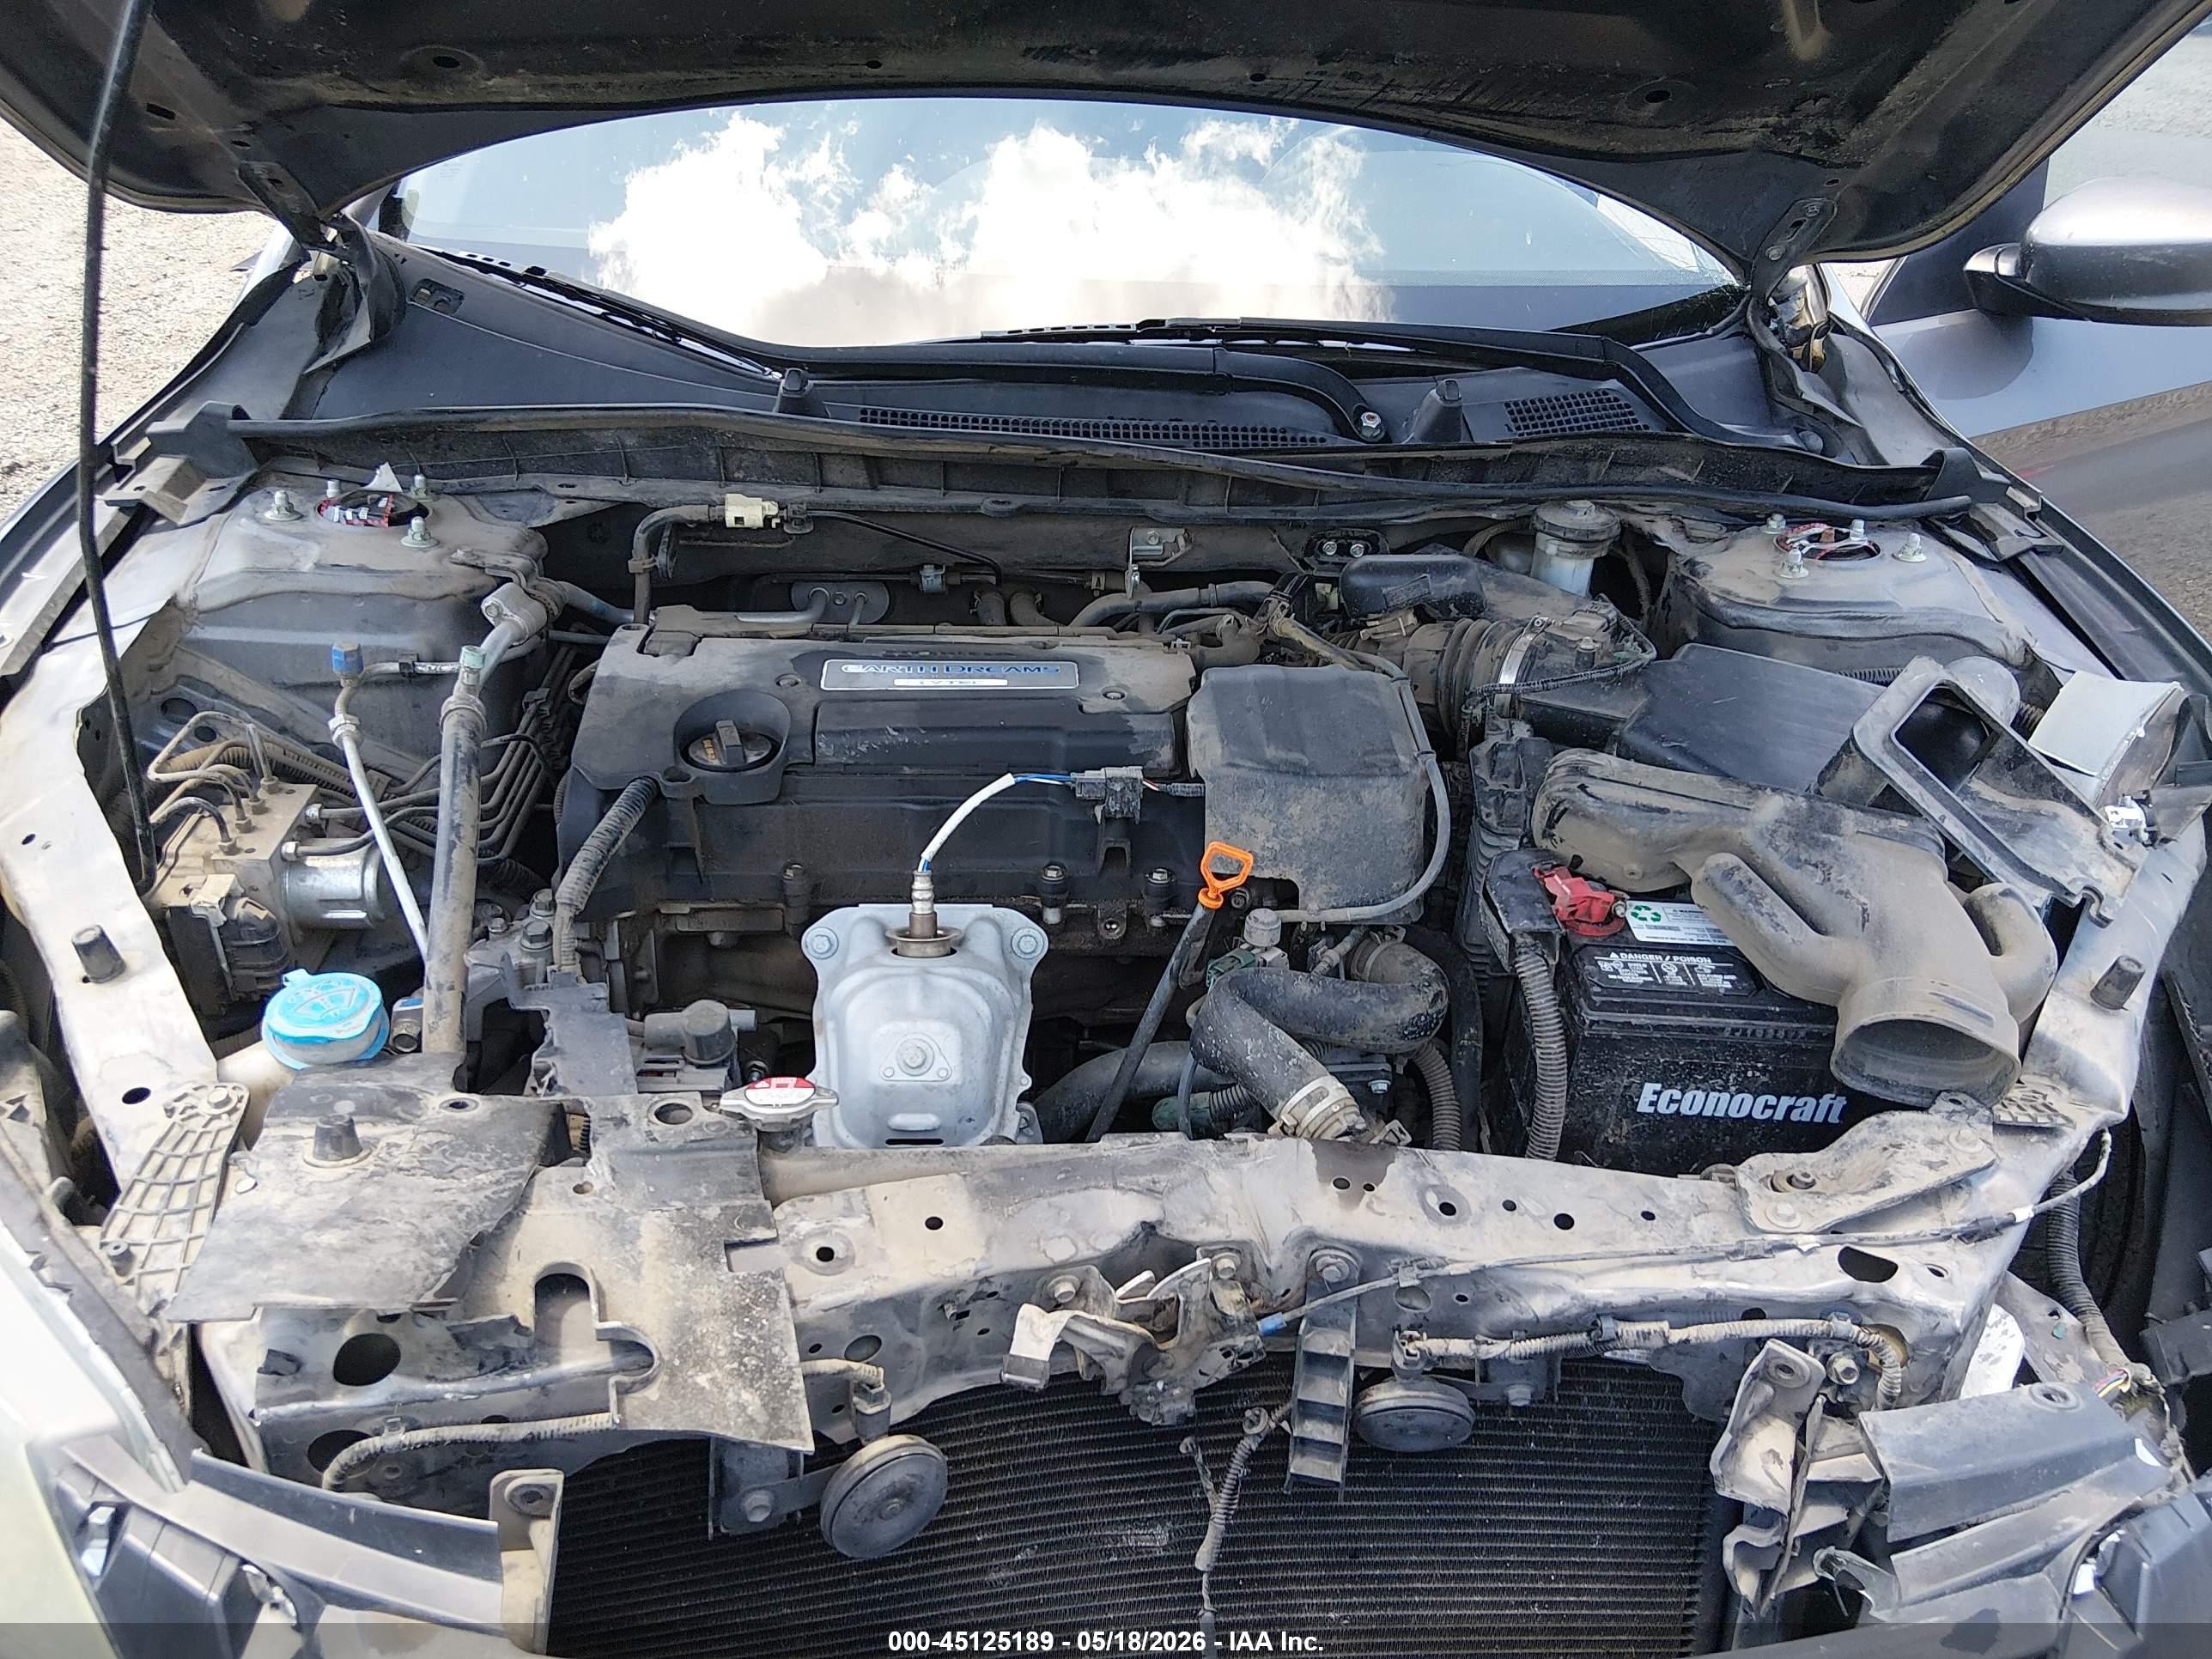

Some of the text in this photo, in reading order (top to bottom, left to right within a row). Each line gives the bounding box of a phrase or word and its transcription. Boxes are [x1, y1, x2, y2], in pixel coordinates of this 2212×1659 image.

[841, 664, 1060, 675] EARTH DREAMS
[1620, 952, 1662, 962] DANGER
[1673, 955, 1711, 963] POISON
[1637, 1082, 1847, 1124] Econocraft
